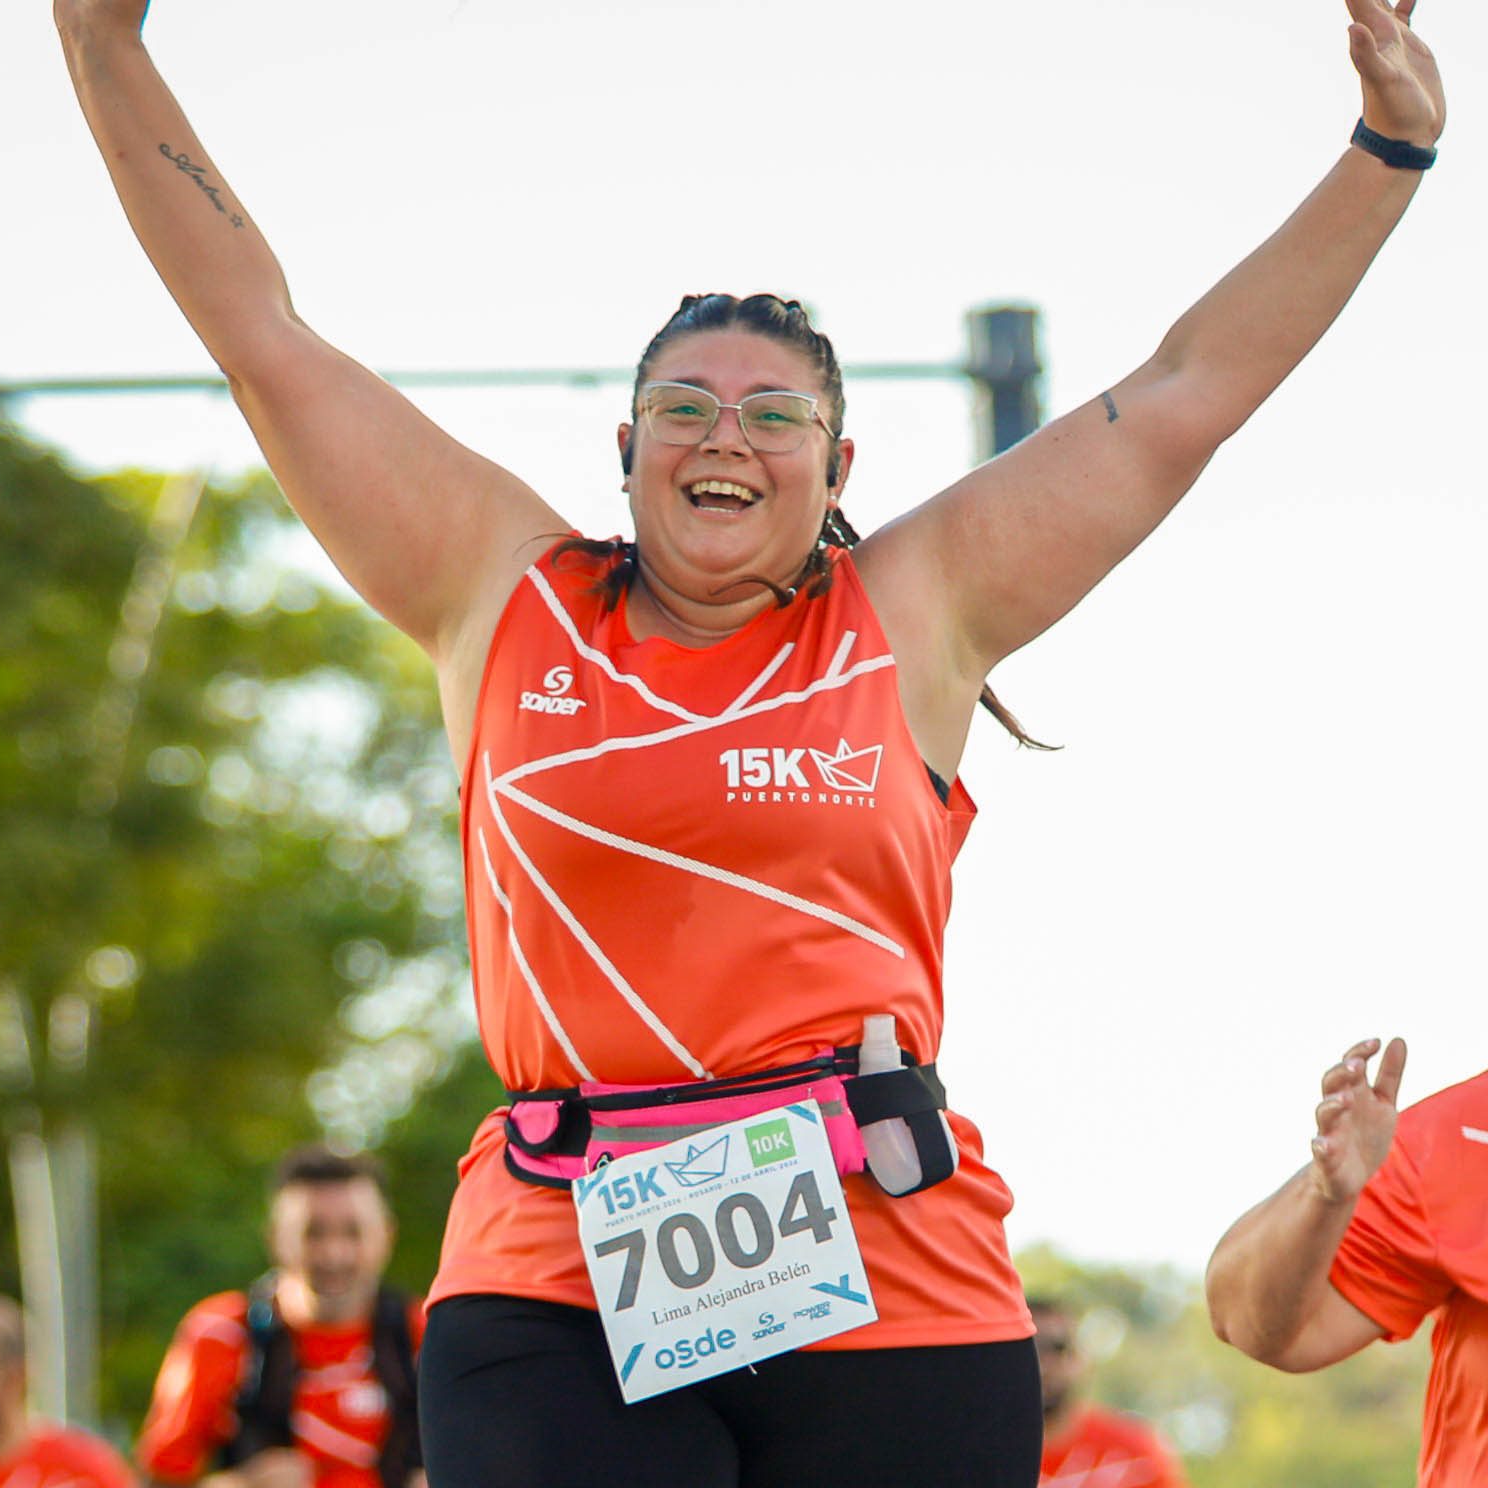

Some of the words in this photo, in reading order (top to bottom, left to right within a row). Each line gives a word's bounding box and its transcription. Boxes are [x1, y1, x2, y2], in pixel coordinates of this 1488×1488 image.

[719, 748, 810, 787] 15K
[727, 791, 811, 803] PUERTO
[818, 793, 876, 808] NORTE
[752, 1131, 789, 1155] 10K
[597, 1165, 667, 1215] 15K
[593, 1170, 836, 1313] 7004
[651, 1306, 692, 1326] Lima
[696, 1277, 766, 1308] Alejandra
[768, 1262, 811, 1287] Belén
[654, 1327, 737, 1369] osde
